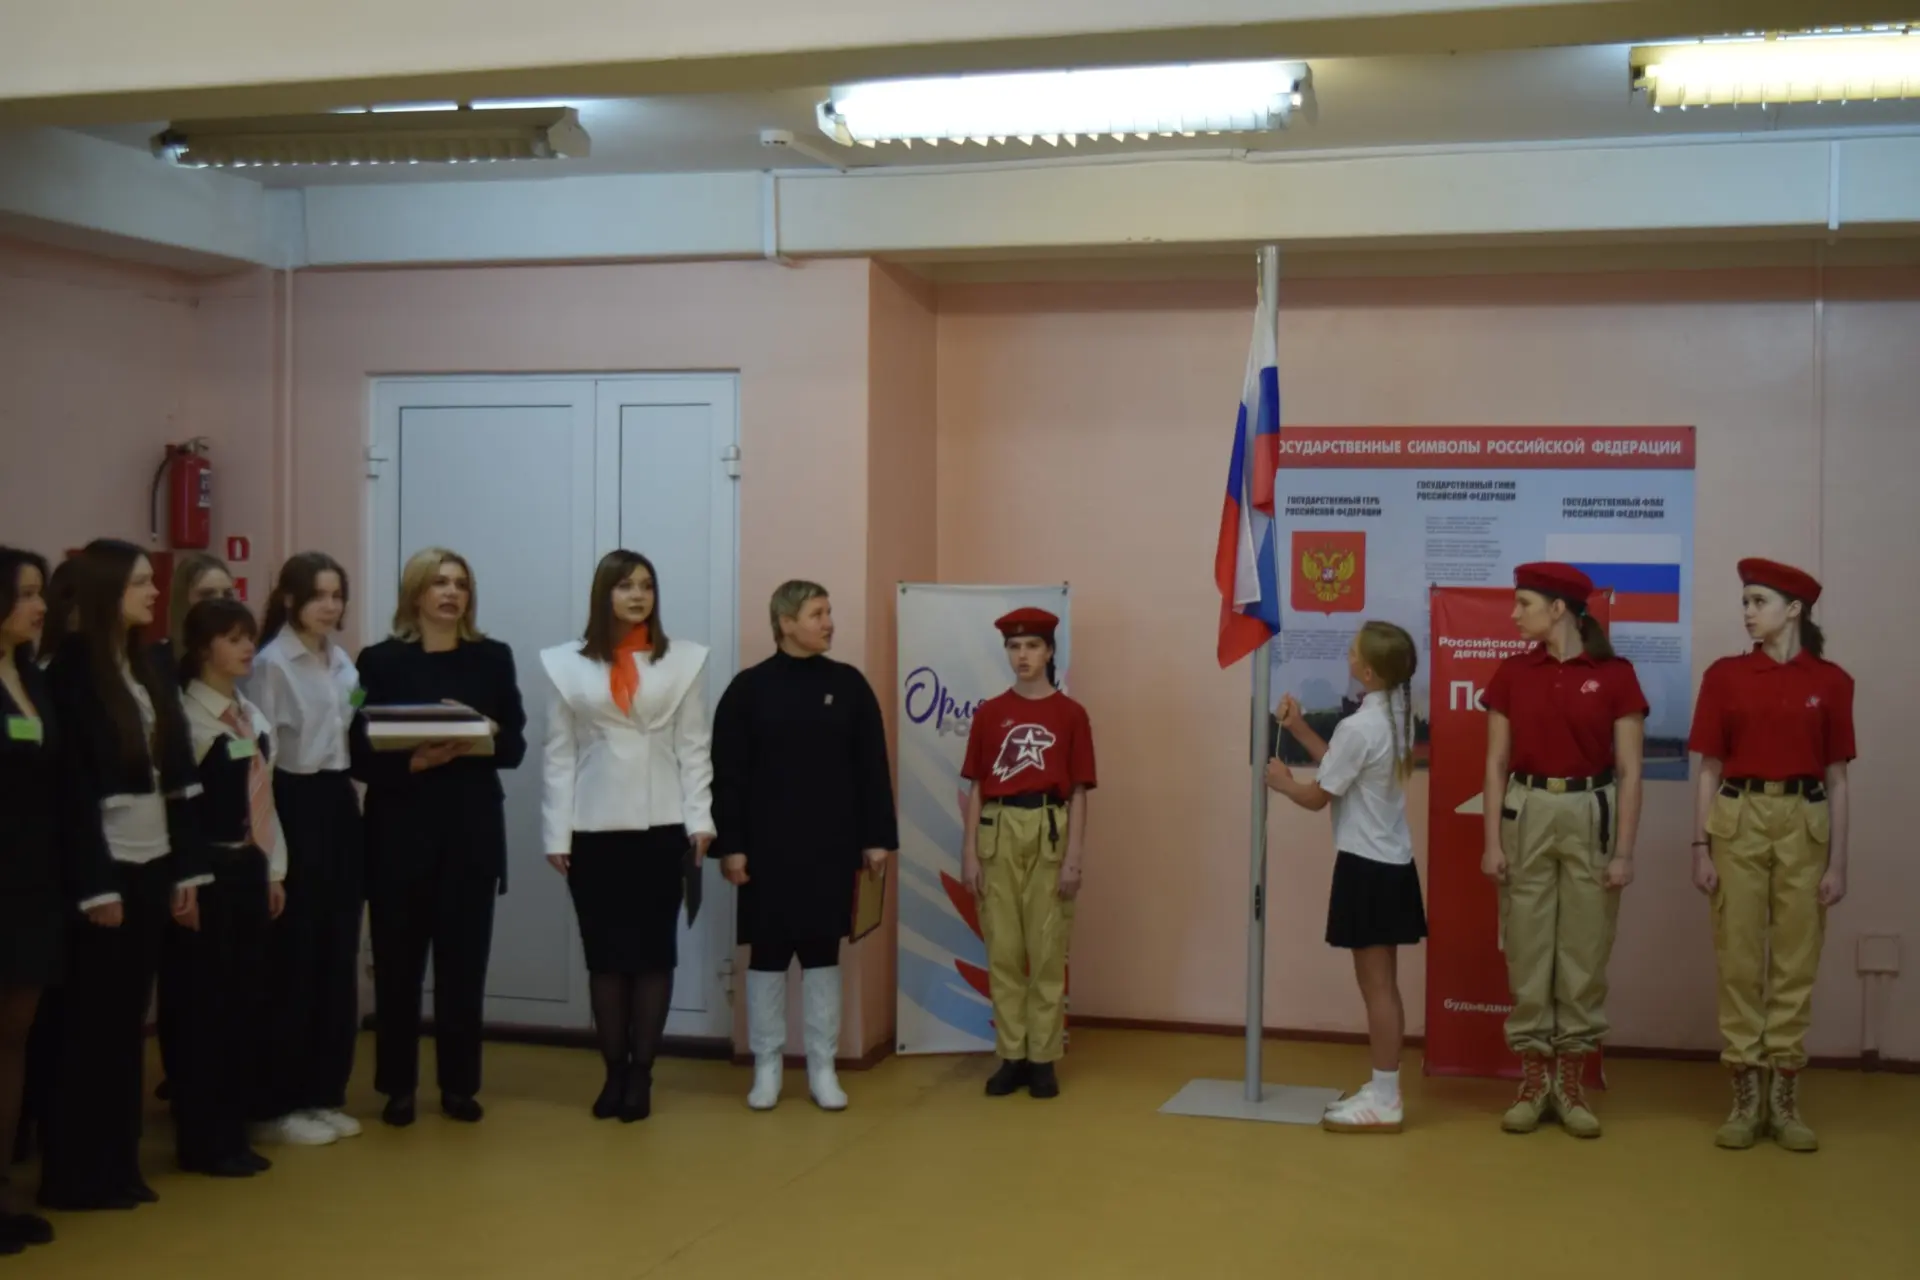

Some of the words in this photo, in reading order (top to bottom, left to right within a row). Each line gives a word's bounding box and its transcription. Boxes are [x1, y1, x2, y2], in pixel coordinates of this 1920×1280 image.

[1279, 439, 1401, 456] ОСУДАРСТВЕННЫЕ
[1407, 439, 1480, 454] СИМВОЛЫ
[1487, 438, 1585, 454] РОССИЙСКОЙ
[1592, 439, 1682, 456] ФЕДЕРАЦИИ
[1417, 480, 1492, 490] ГОСУДАРСТВЕННЫЙ
[1287, 495, 1361, 506] ГОСУДАРСТВЕННЫЙ
[1417, 491, 1467, 501] РОССИЙСКОЙ
[1469, 492, 1516, 502] ФЕДЕРАЦИИ
[1562, 497, 1640, 507] ГОСУДАРСТВЕННЫЙ
[1285, 506, 1334, 517] РОССИЙСКОЙ
[1336, 507, 1382, 518] ФЕДЕРАЦИИ
[1562, 508, 1615, 518] РОССИЙСКОЙ
[1616, 508, 1664, 519] ФЕДЕРАЦИИ
[1438, 636, 1526, 649] Российское
[1453, 649, 1497, 660] детей
[1499, 651, 1508, 659] и
[1443, 998, 1512, 1013] будьвдви
